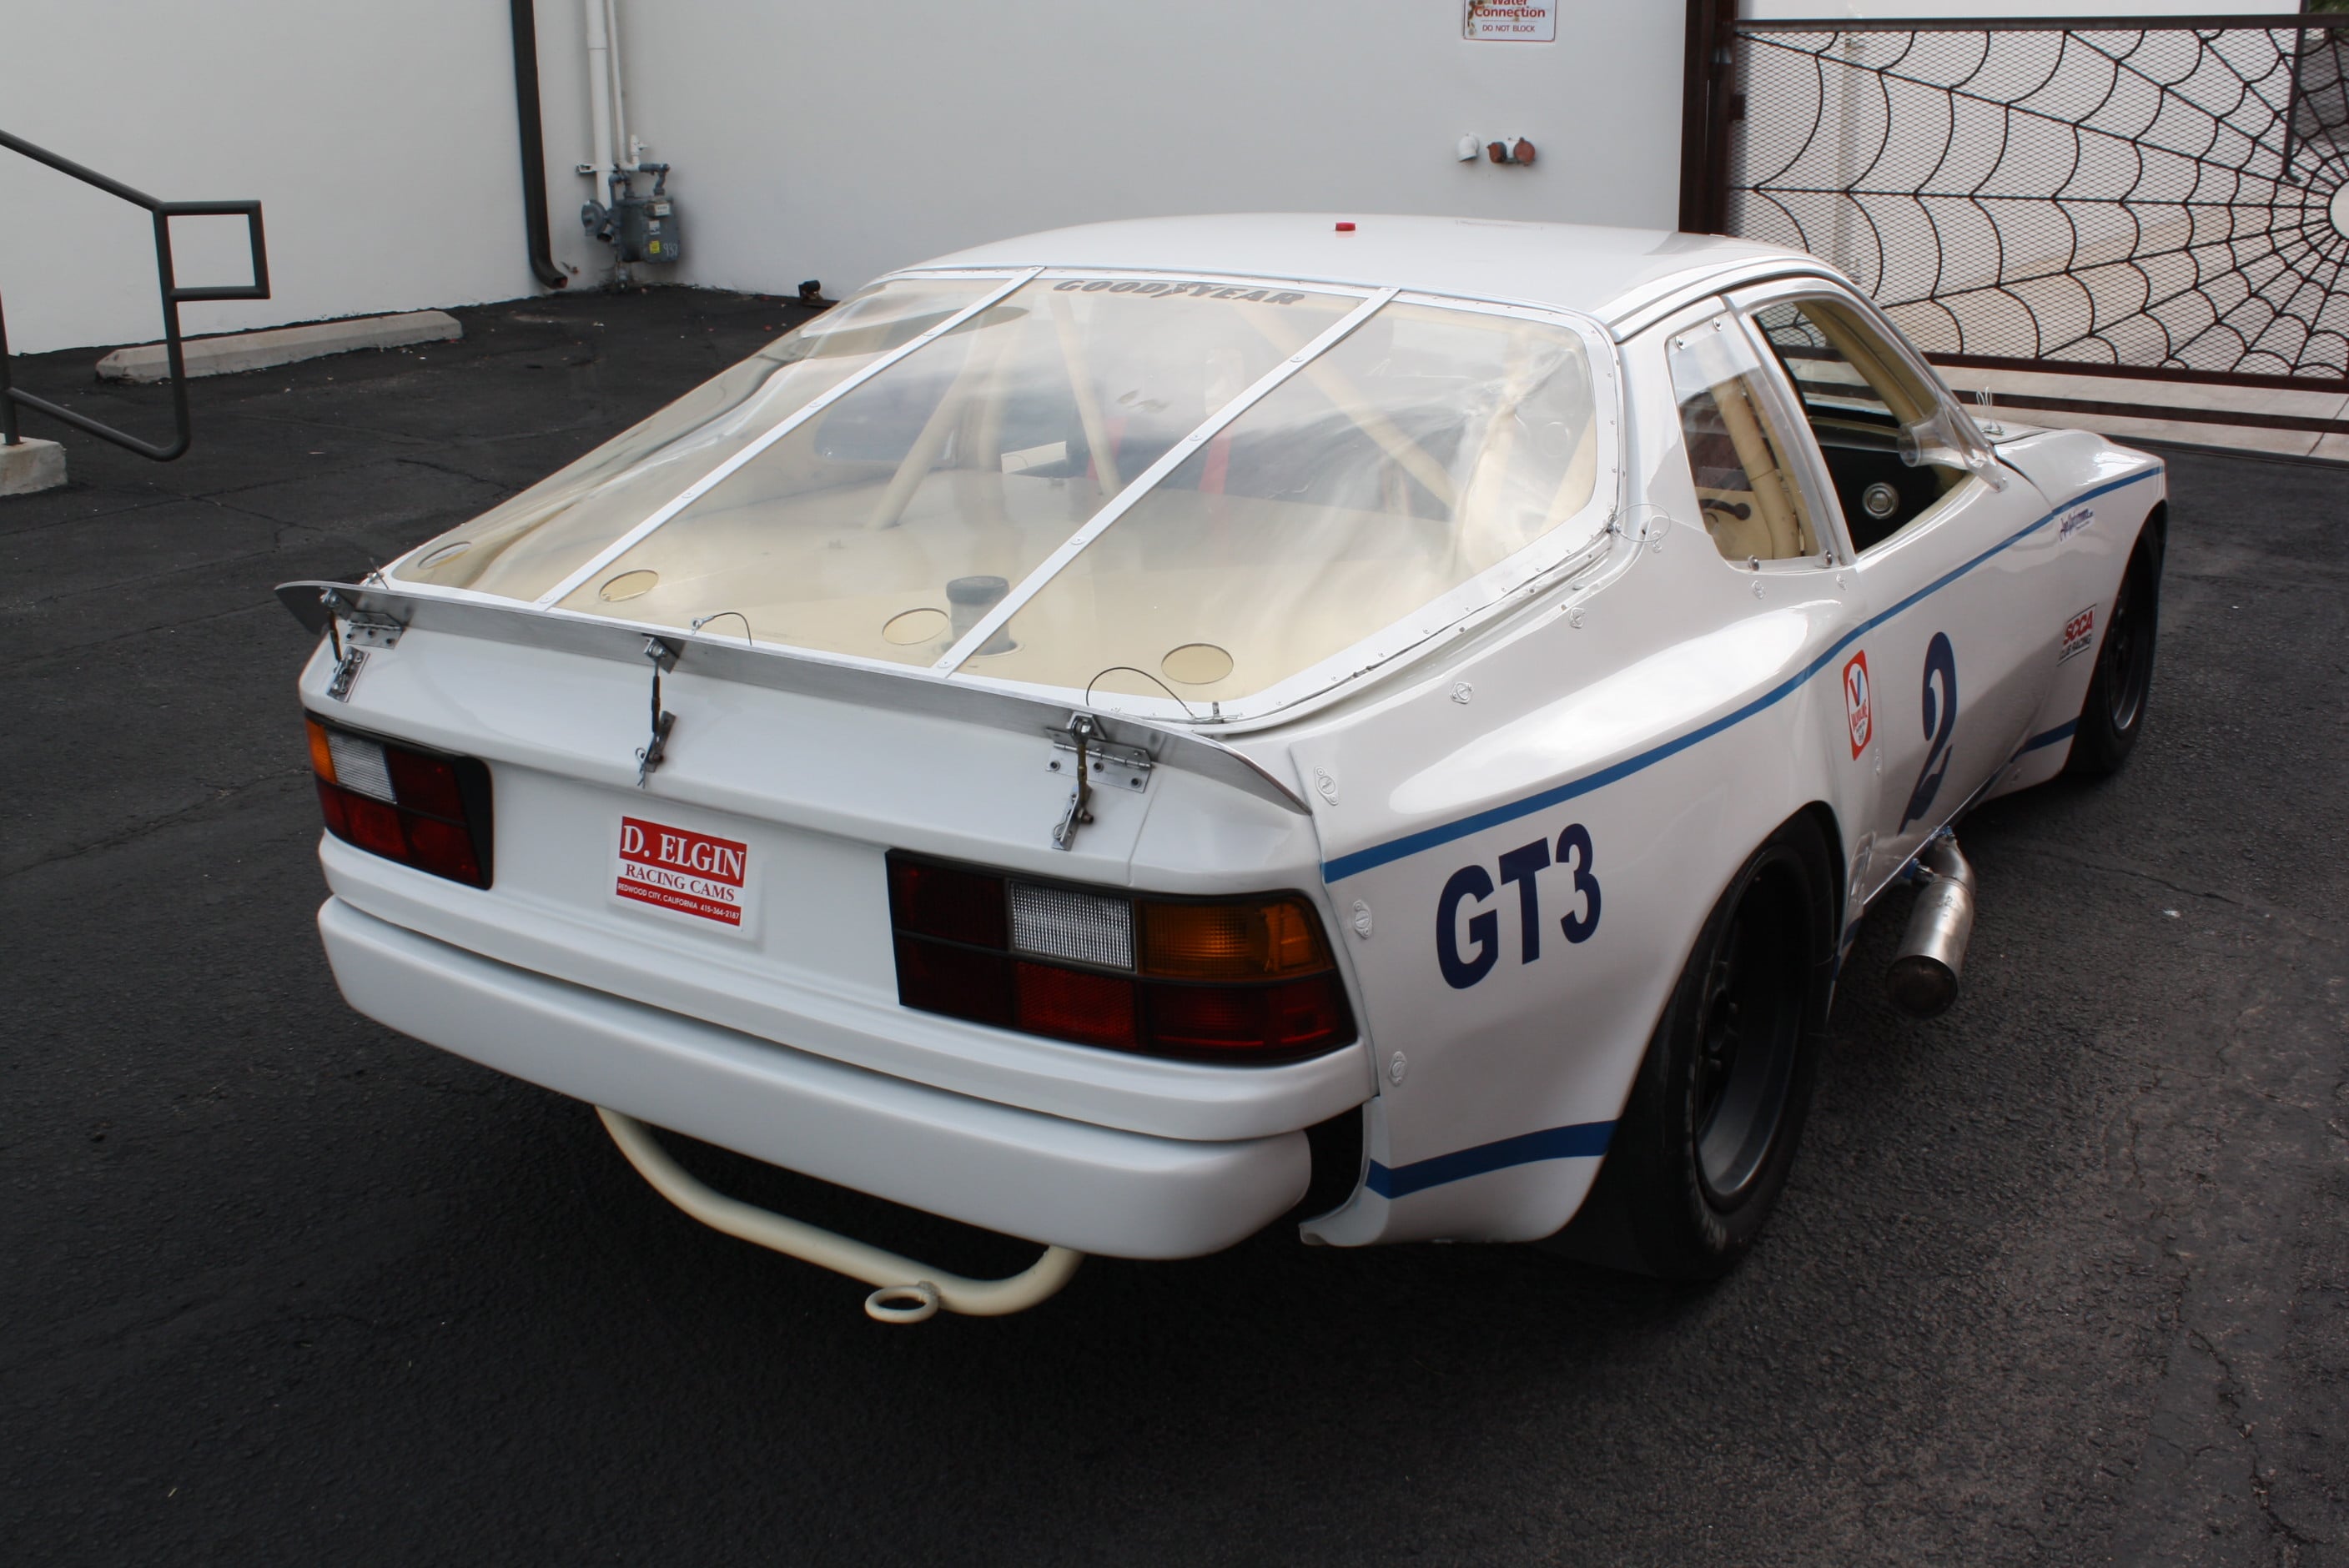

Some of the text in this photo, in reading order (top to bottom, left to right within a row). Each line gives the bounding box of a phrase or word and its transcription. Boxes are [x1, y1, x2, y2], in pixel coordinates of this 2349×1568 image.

[1475, 7, 1545, 17] Connection
[1053, 280, 1305, 304] GOODYEAR
[2064, 610, 2093, 646] SCCA
[1897, 631, 1957, 837] 2
[621, 825, 745, 881] D. ELGIN
[617, 882, 740, 920] REDWOOD CITY, CALIFORNIA 415-364-2187
[626, 863, 735, 902] RACING CAMS
[1436, 823, 1602, 990] GT3
